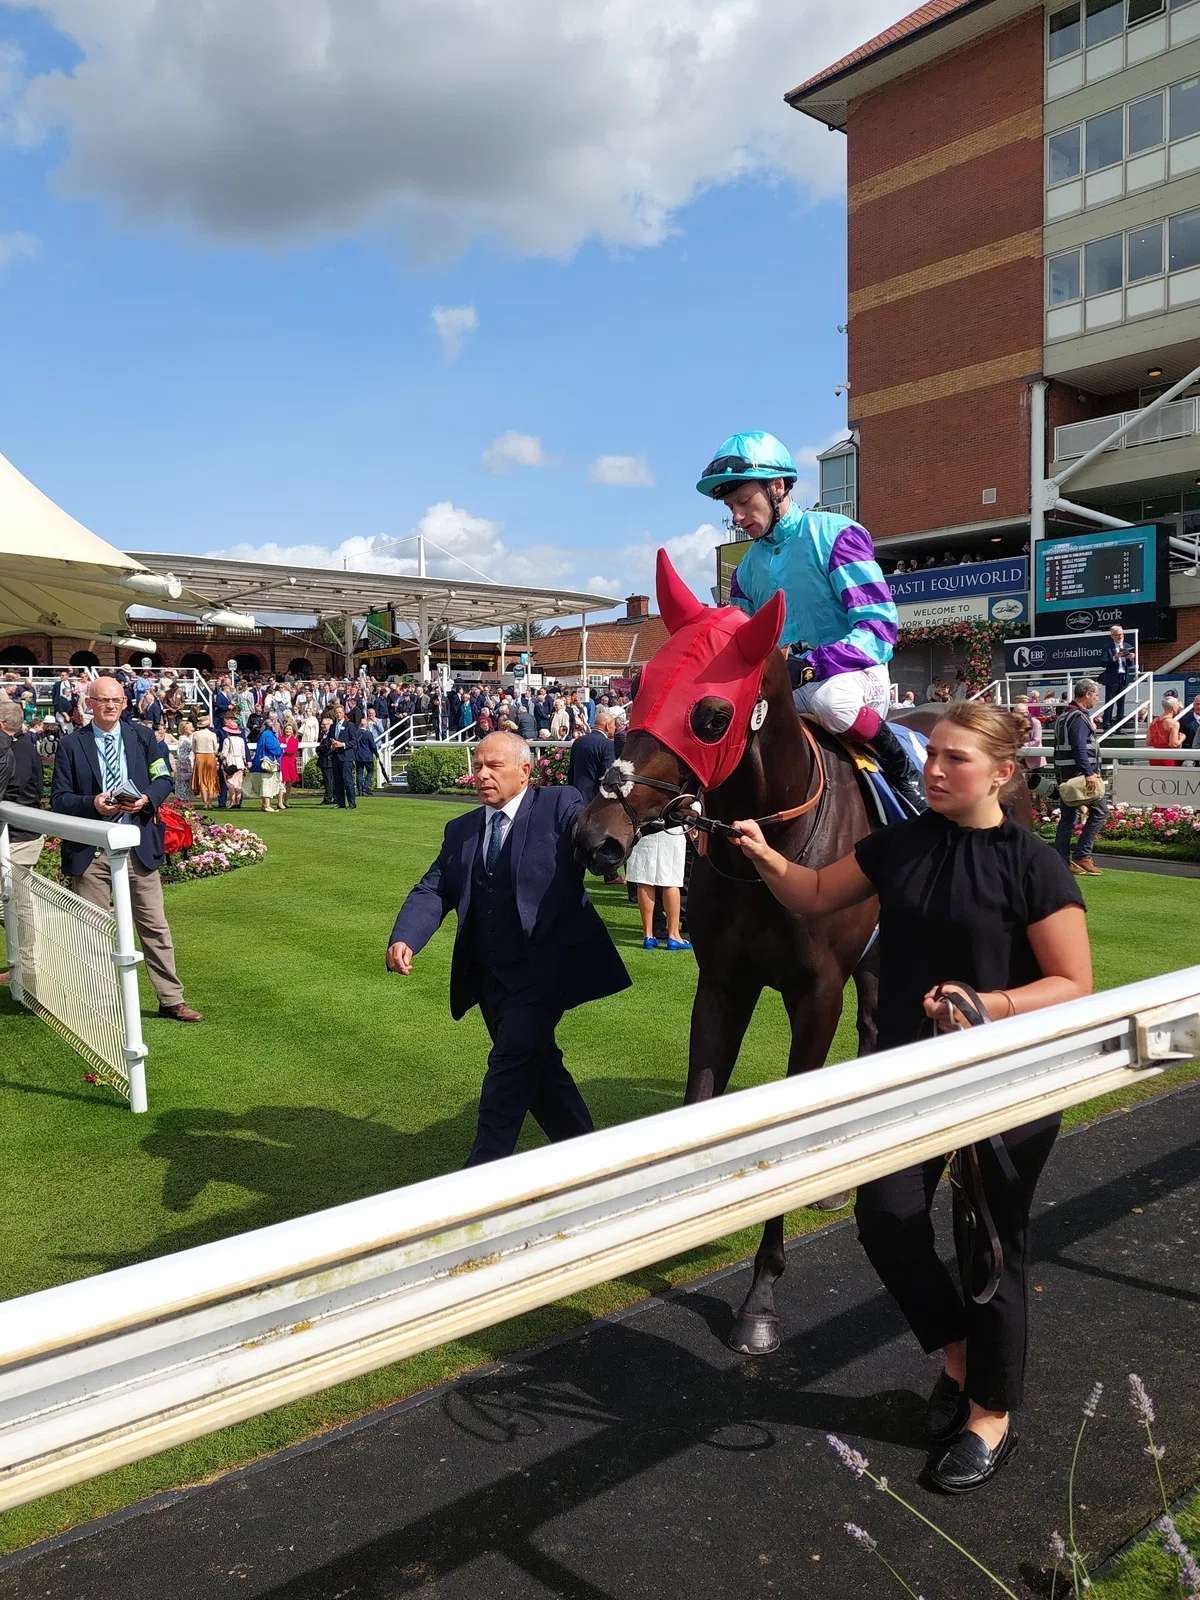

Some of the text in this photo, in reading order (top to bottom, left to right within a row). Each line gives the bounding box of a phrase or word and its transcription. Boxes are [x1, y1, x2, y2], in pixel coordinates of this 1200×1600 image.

[890, 568, 1022, 596] BASTI EQUIWORLD
[913, 604, 970, 617] WELCOME TO
[1095, 608, 1123, 622] York
[901, 614, 983, 628] YORK RACECOURSE
[1030, 647, 1103, 660] EBF ebfstallions
[756, 713, 762, 725] 6
[1138, 777, 1200, 796] COOLM
